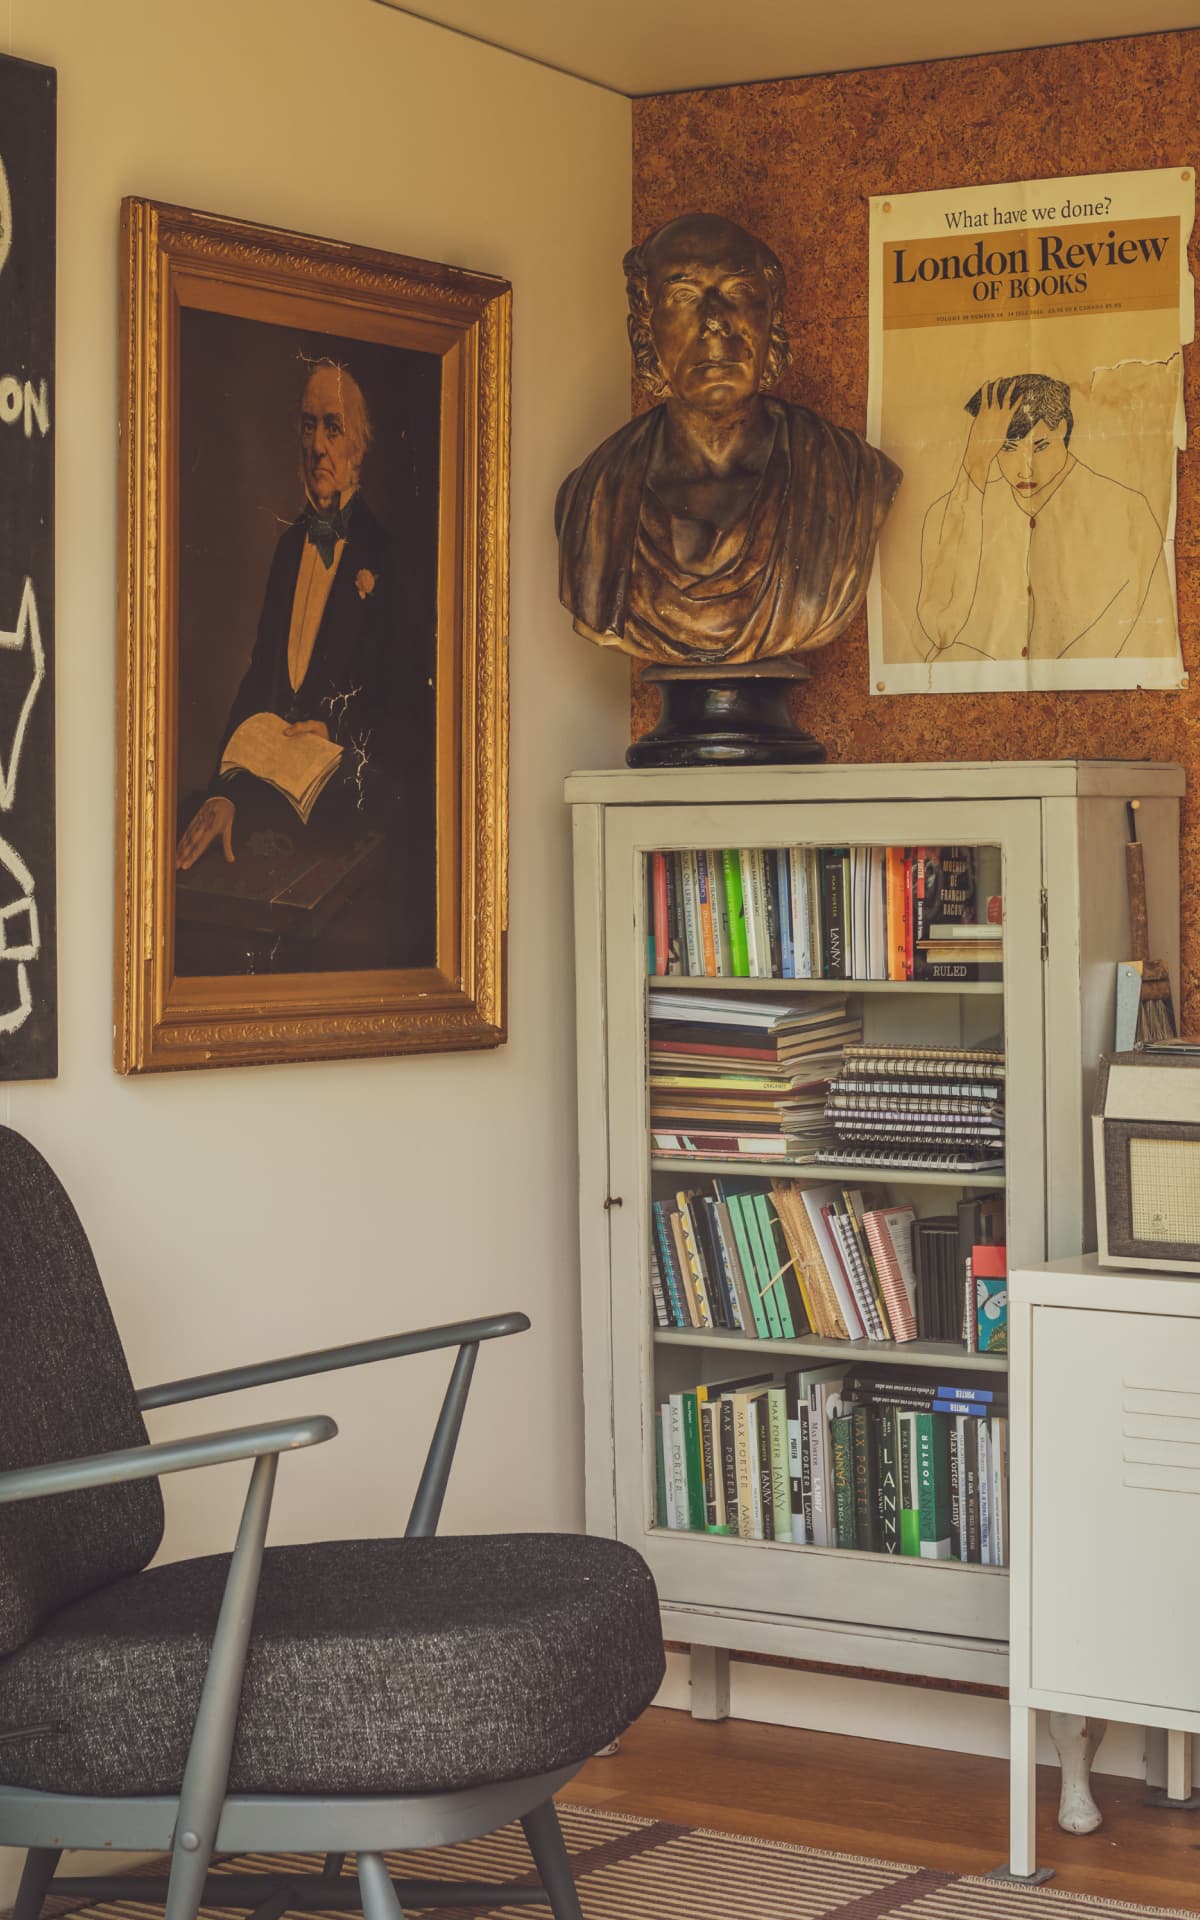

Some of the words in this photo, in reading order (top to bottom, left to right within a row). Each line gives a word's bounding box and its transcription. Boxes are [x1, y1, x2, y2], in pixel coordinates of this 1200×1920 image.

[944, 210, 989, 230] What
[993, 206, 1028, 226] have
[1032, 205, 1056, 220] we
[1061, 196, 1112, 220] done?
[893, 240, 1029, 284] London
[1038, 230, 1169, 272] Review
[972, 280, 1003, 302] OF
[1010, 272, 1088, 299] BOOKS
[830, 927, 841, 968] LANNY
[933, 965, 967, 977] RULED
[771, 1400, 779, 1422] MAX
[950, 1403, 969, 1413] PORTER
[955, 1389, 975, 1399] PORTER
[671, 1407, 680, 1433] MAX
[723, 1405, 732, 1432] MAX
[736, 1411, 745, 1437] MAX
[855, 1414, 865, 1448] MAX
[703, 1434, 713, 1470] LANNY
[773, 1425, 781, 1459] PORTER
[950, 1430, 959, 1453] Max
[672, 1445, 683, 1492] PORTER
[726, 1447, 736, 1495] PORTER
[740, 1442, 749, 1489] PORTER
[802, 1450, 810, 1487] PORTER
[834, 1443, 846, 1487] LANNY
[921, 1434, 929, 1486] PORTER
[951, 1456, 960, 1489] Porter
[761, 1470, 771, 1505] LANNY
[773, 1466, 784, 1512] LANNY
[814, 1478, 823, 1512] LANNY
[856, 1455, 868, 1516] PORTER
[883, 1448, 897, 1555] LANNY
[804, 1502, 814, 1530] LANNY
[951, 1494, 960, 1528] Lanny
